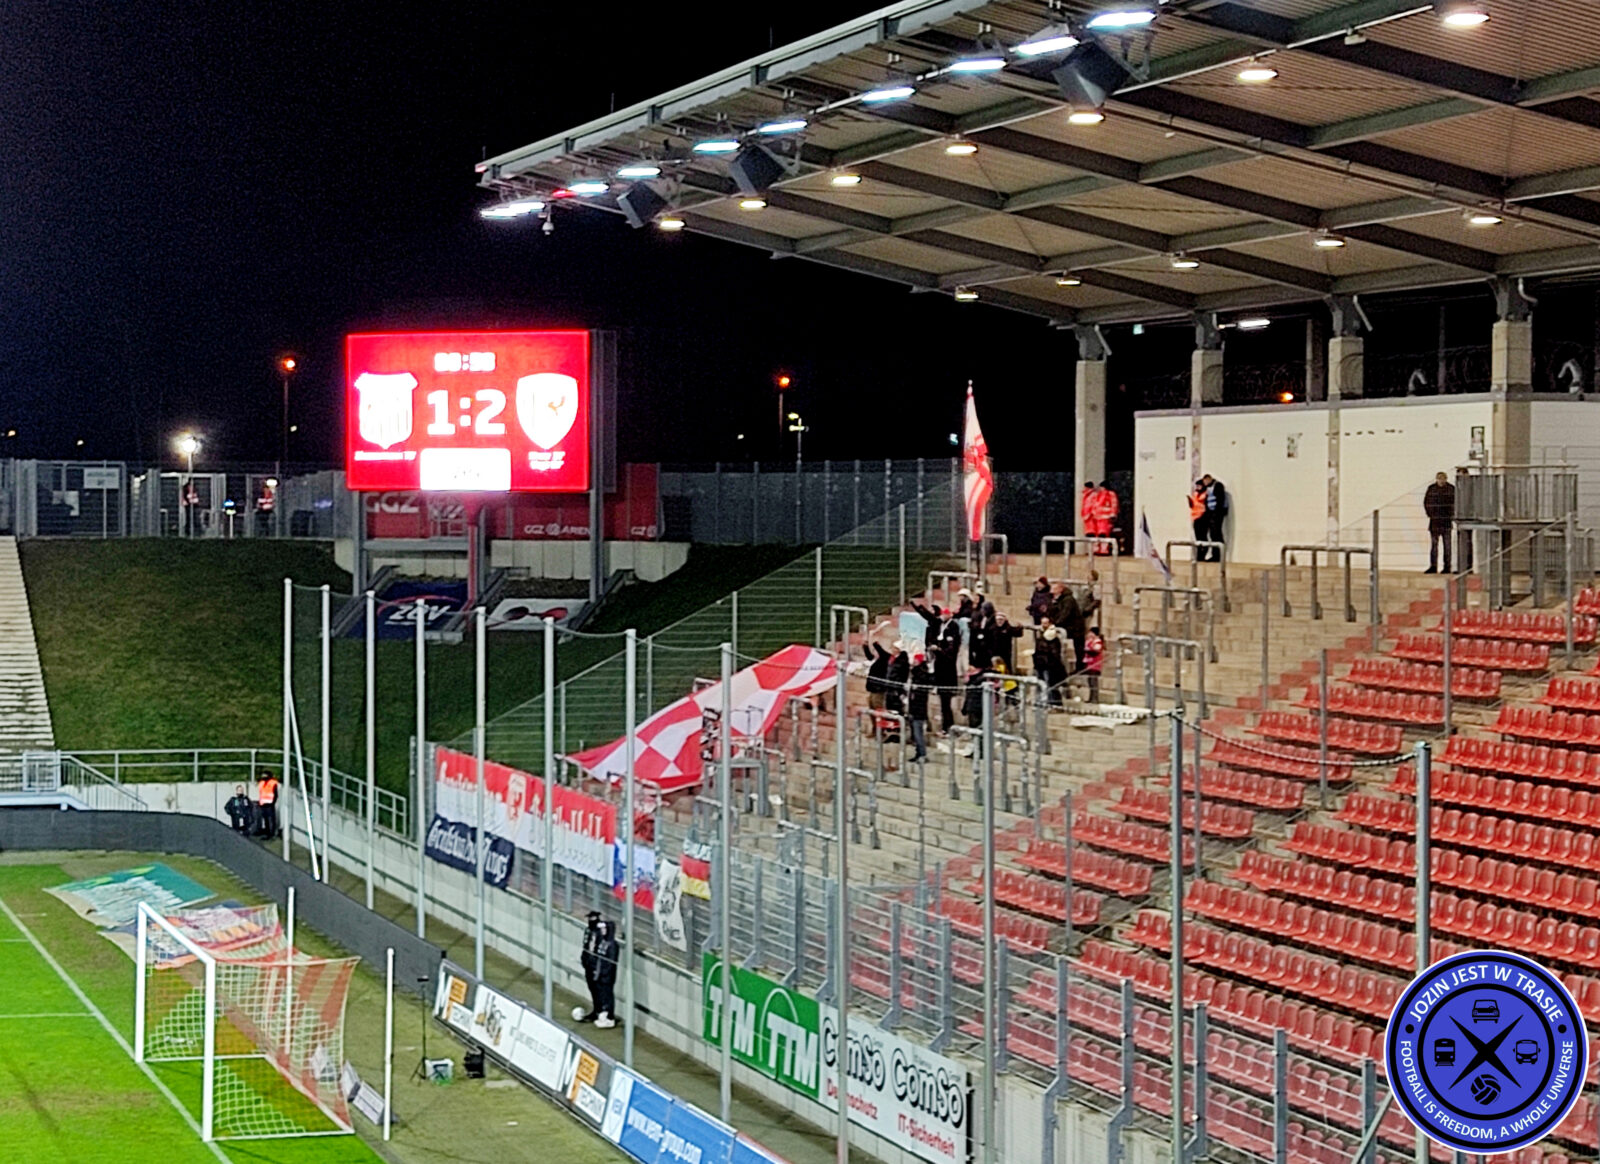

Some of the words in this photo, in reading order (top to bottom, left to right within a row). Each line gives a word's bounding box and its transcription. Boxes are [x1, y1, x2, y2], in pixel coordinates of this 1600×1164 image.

[427, 389, 507, 436] 1:2
[560, 525, 591, 535] AREN
[765, 1011, 818, 1090] TTM
[822, 1016, 886, 1092] CmSo
[890, 1048, 966, 1129] ComSo
[897, 1112, 956, 1160] IT-Sicherheit
